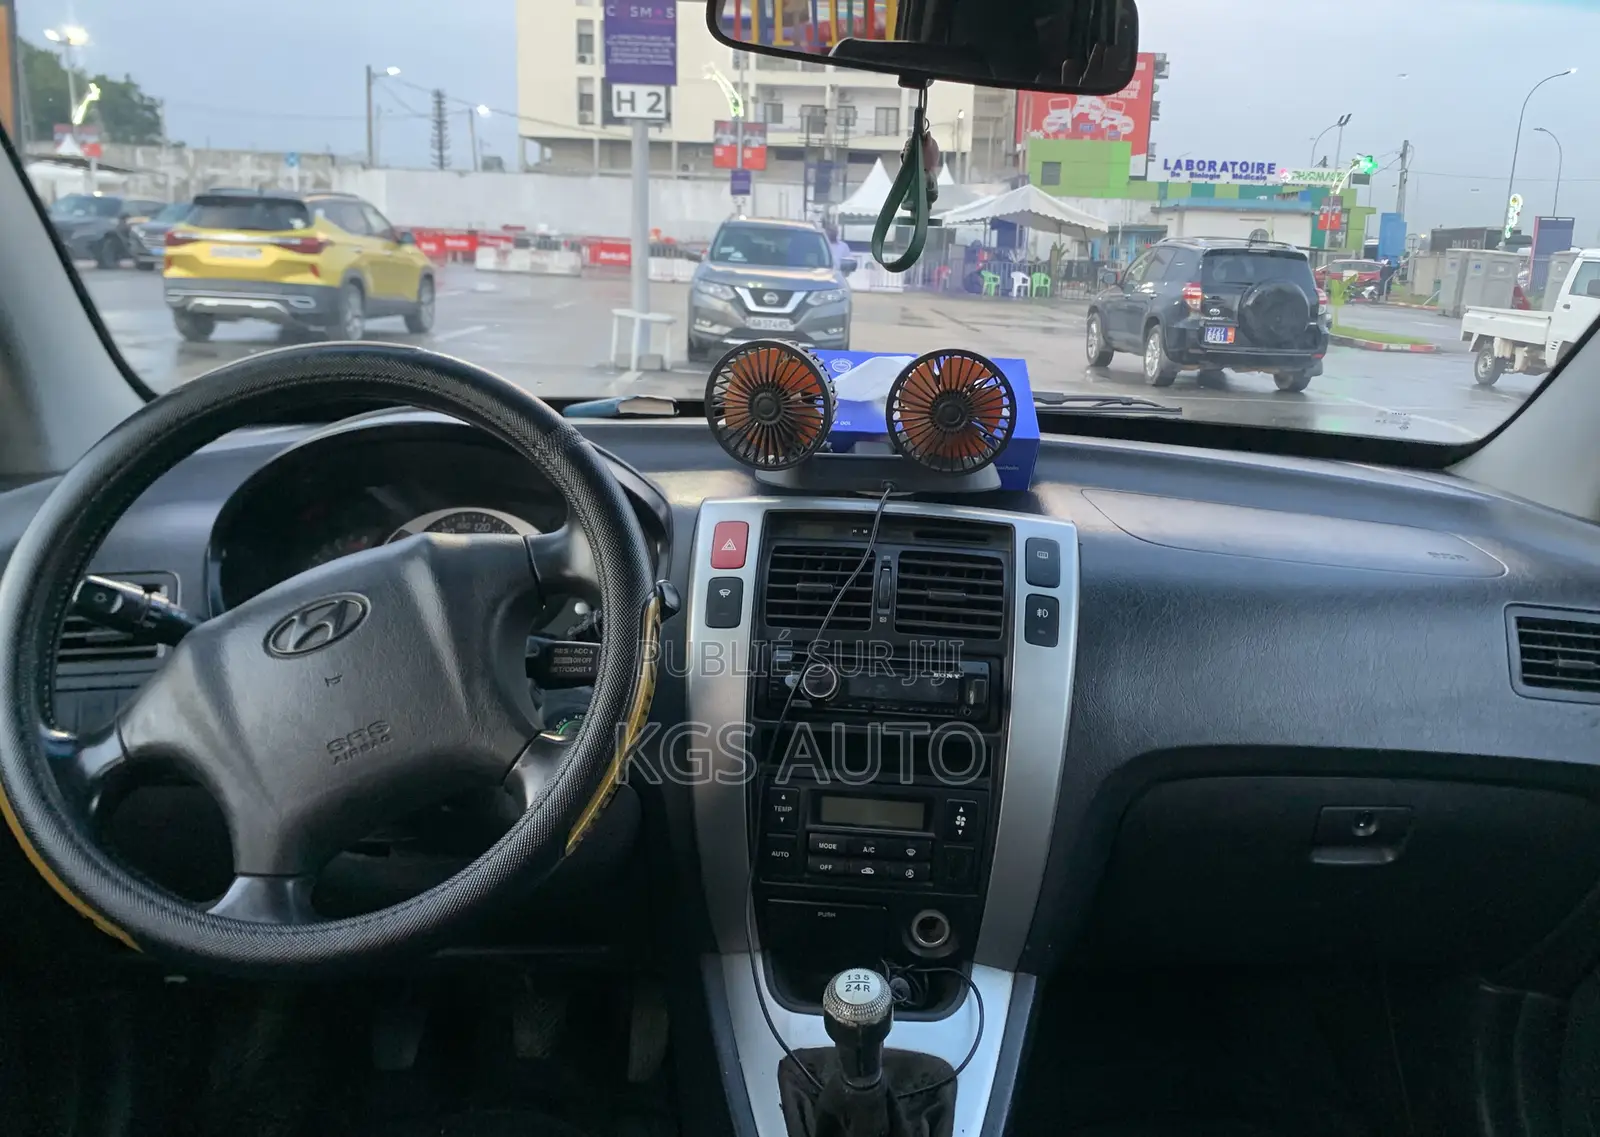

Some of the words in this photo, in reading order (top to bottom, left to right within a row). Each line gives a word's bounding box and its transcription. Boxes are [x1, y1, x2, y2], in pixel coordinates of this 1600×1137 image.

[606, 5, 675, 18] CSMS
[616, 91, 636, 112] H
[646, 91, 663, 113] 2
[1163, 159, 1277, 174] LABORATOIRE
[1189, 171, 1221, 180] Biologie
[818, 842, 837, 850] MODE
